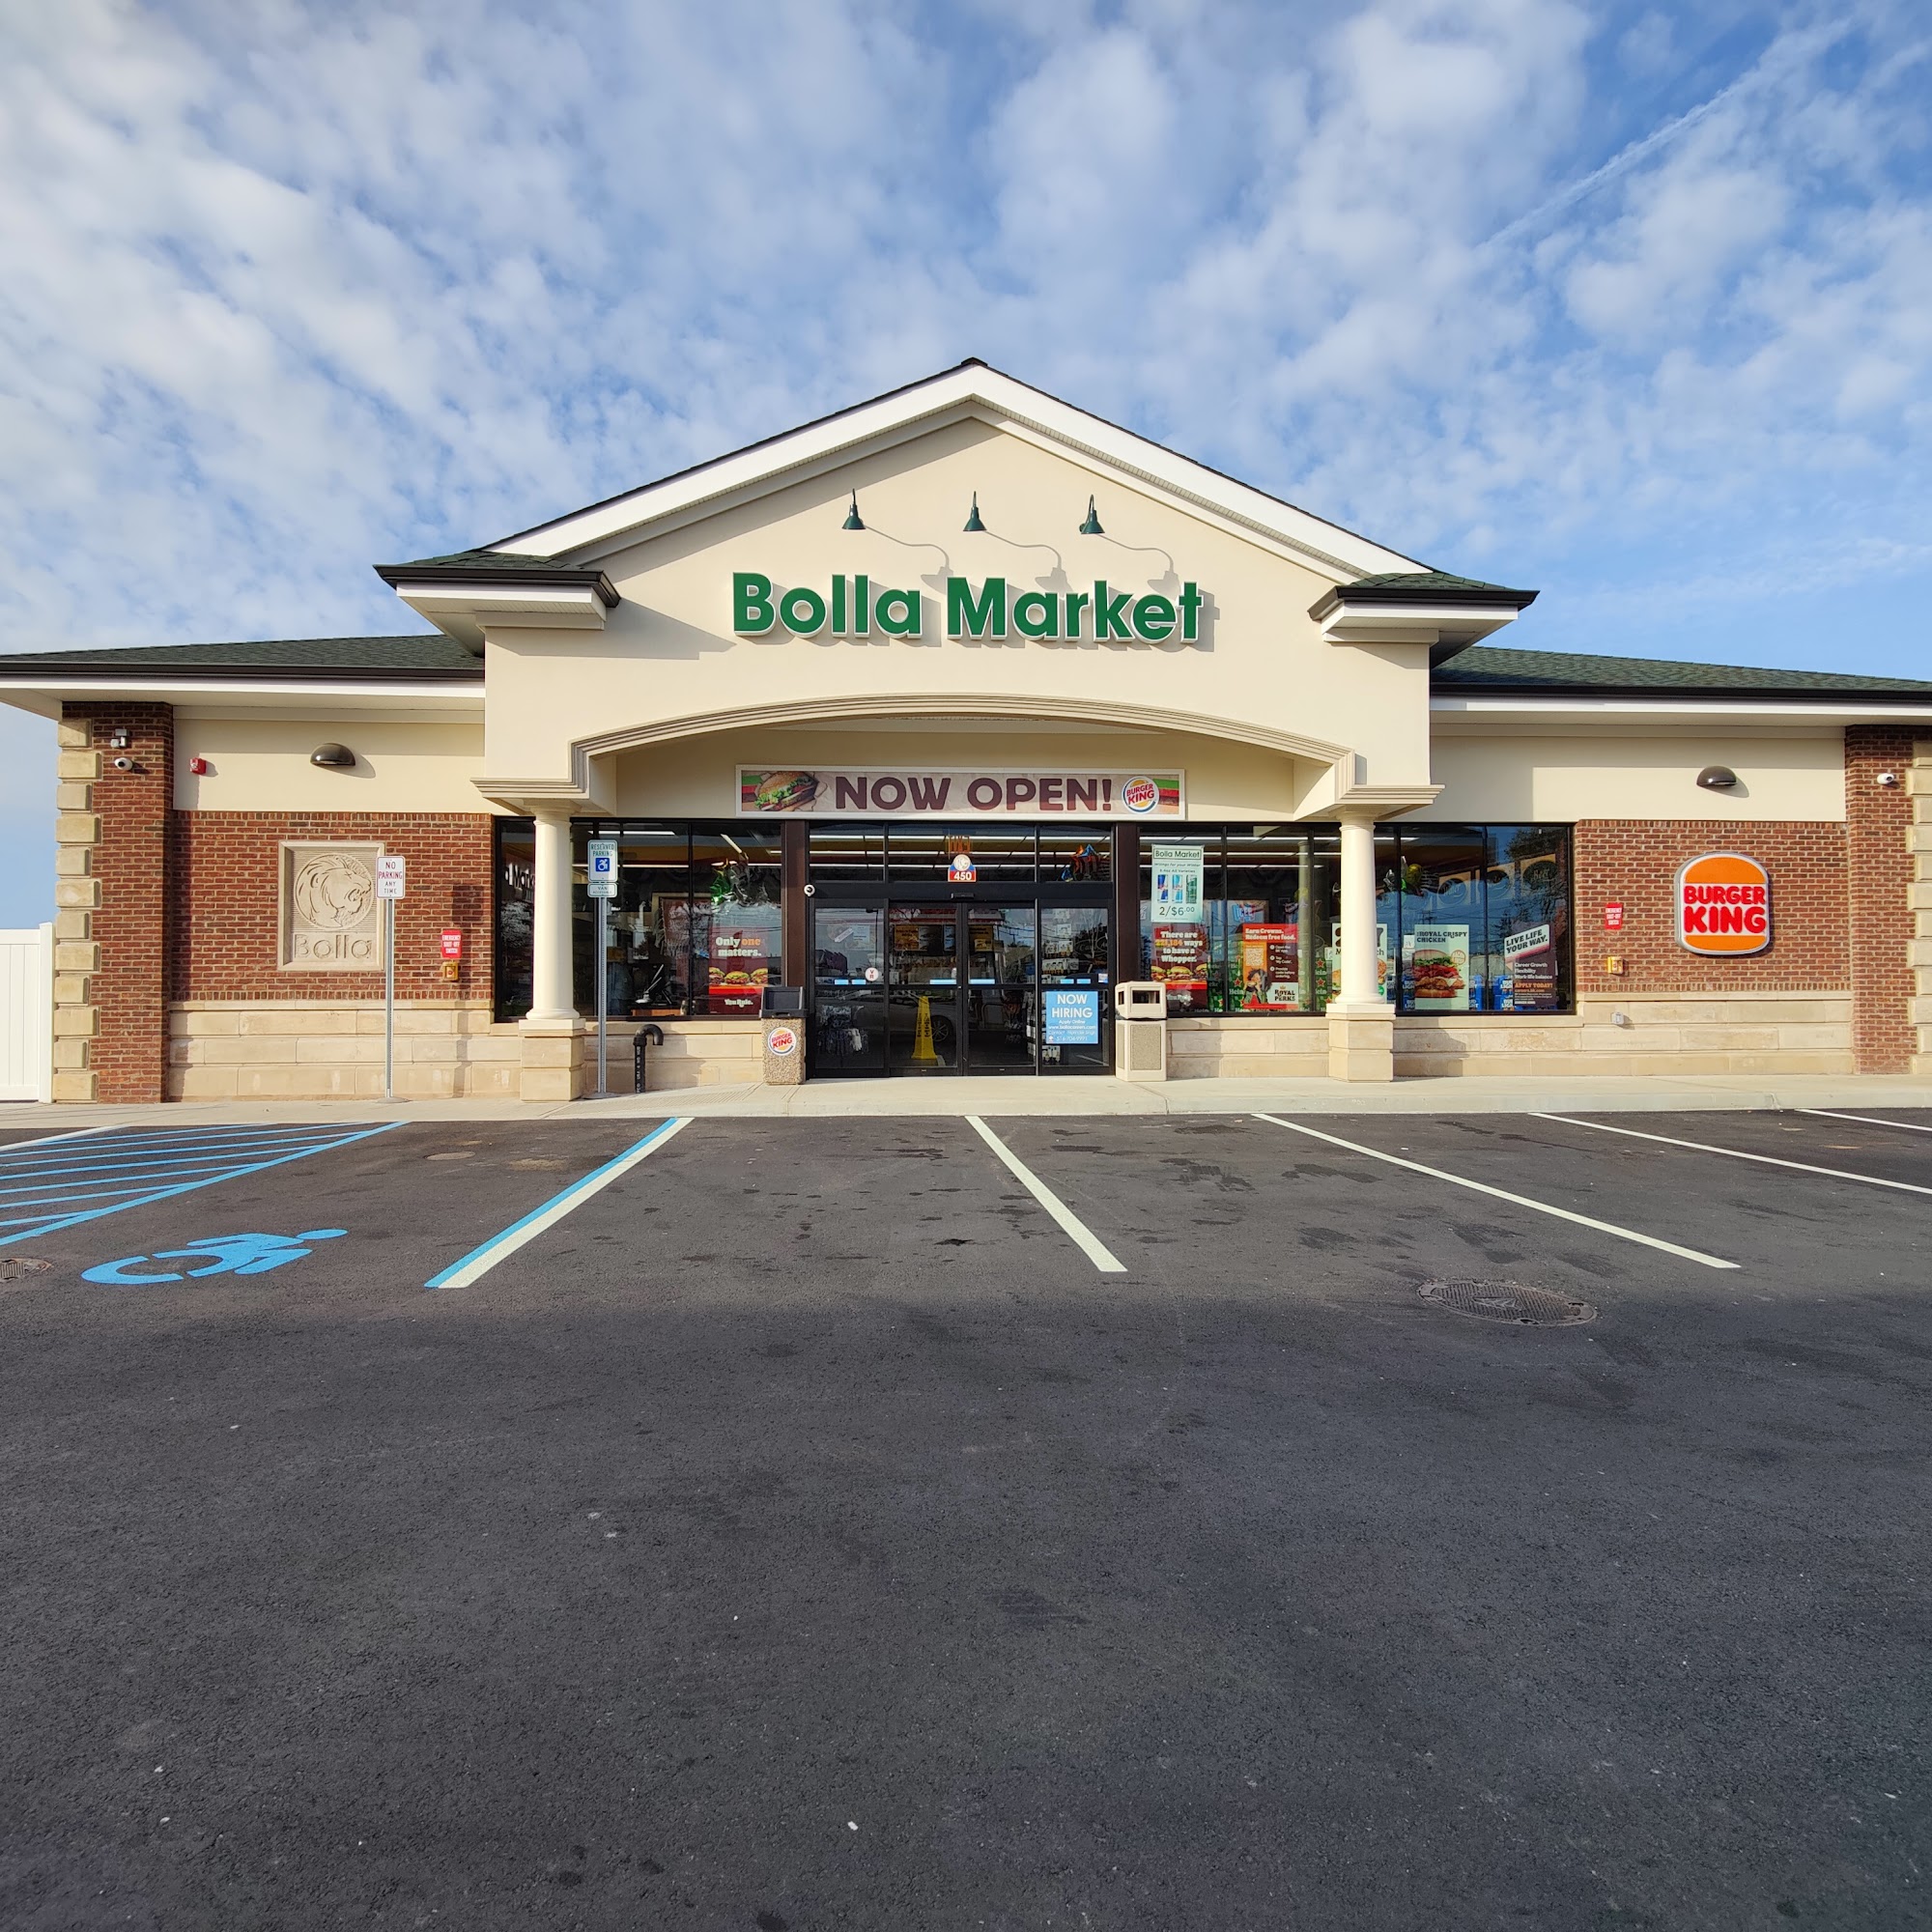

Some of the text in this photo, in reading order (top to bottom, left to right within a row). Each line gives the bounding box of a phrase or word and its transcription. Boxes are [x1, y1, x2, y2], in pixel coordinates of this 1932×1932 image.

[732, 572, 1203, 643] Bolla Market
[836, 776, 1112, 811] NOW OPEN!
[1126, 783, 1153, 797] BURGER
[1127, 789, 1155, 806] KING
[1174, 850, 1200, 859] Market
[953, 871, 972, 881] 450
[1684, 886, 1766, 904] BURGER
[1684, 906, 1767, 933] KING
[716, 937, 741, 948] Only
[1506, 929, 1543, 947] LIVE LIFE
[1506, 935, 1548, 953] YOUR WAY.
[294, 934, 372, 959] Bolla
[1057, 994, 1088, 1005] NOW
[1274, 989, 1295, 999] ROYAL
[1051, 1007, 1093, 1018] HIRING
[771, 1033, 792, 1042] BURGER
[773, 1037, 793, 1049] KING
